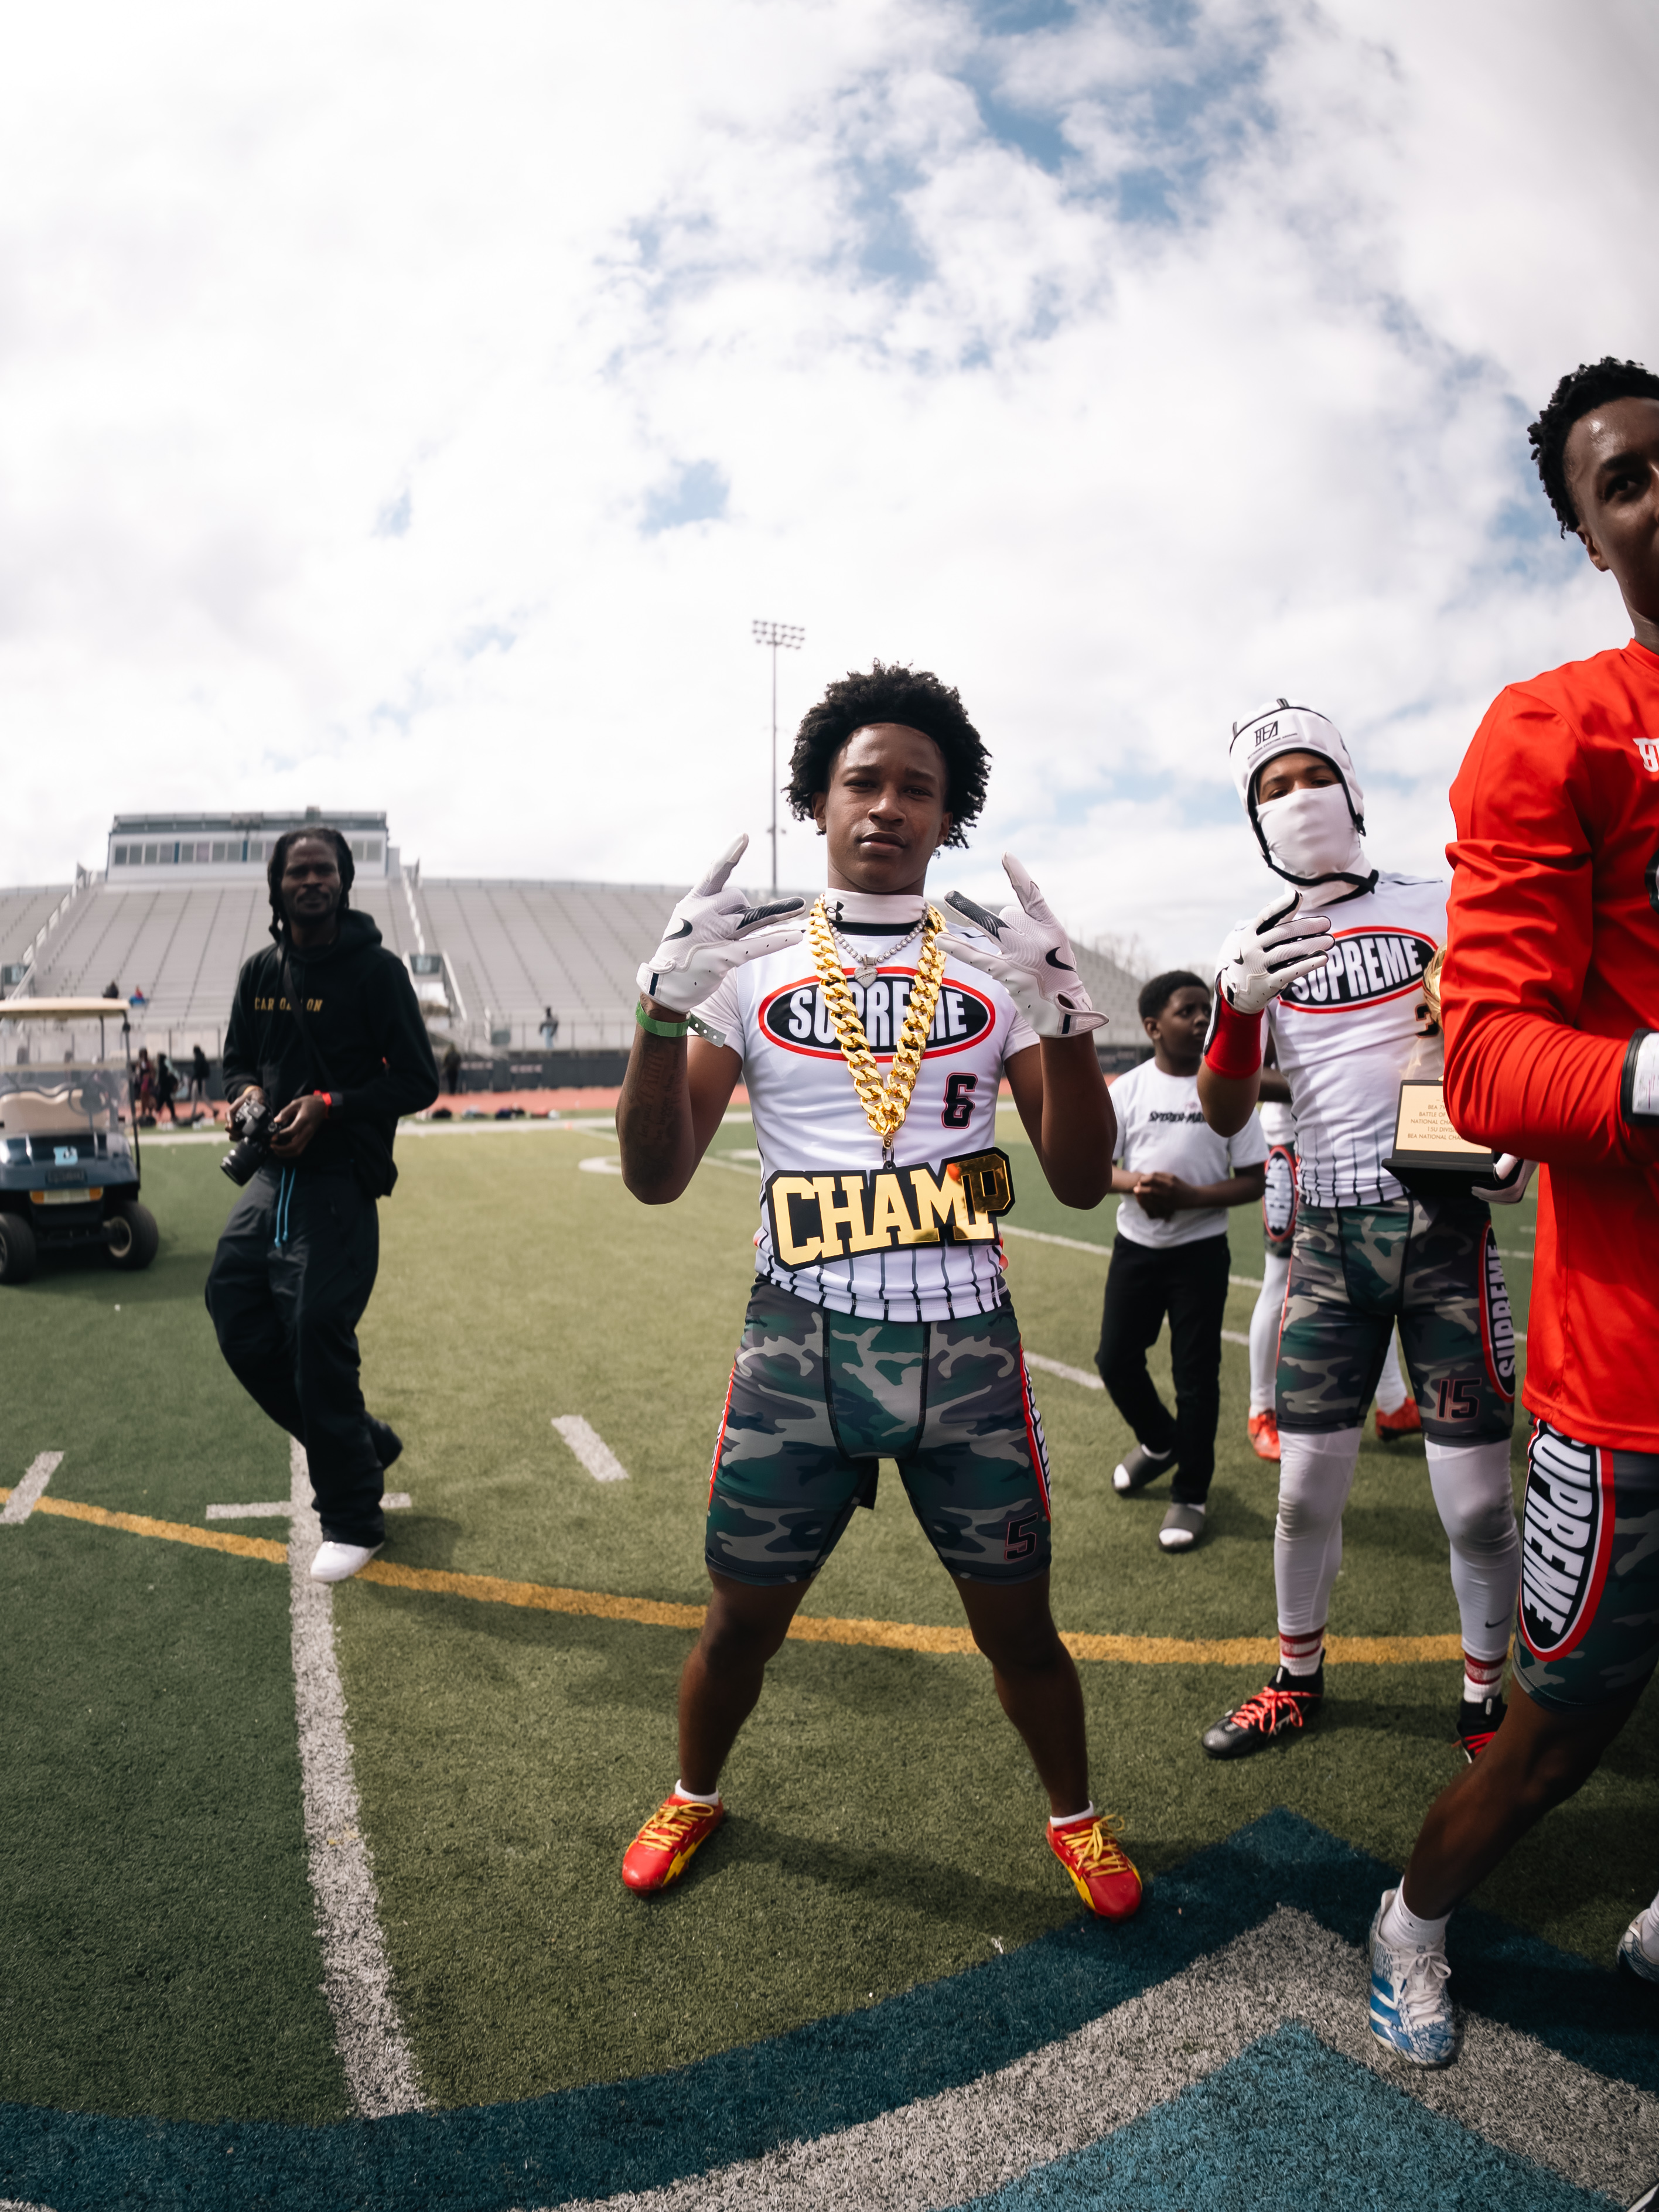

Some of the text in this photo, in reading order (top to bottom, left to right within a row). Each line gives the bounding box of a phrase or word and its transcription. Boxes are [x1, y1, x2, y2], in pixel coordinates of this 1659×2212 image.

[942, 1073, 978, 1129] 6
[772, 1153, 1006, 1266] CHAMP
[1436, 1378, 1482, 1420] 15
[1005, 1512, 1039, 1562] 5
[1524, 1423, 1592, 1635] UPREME
